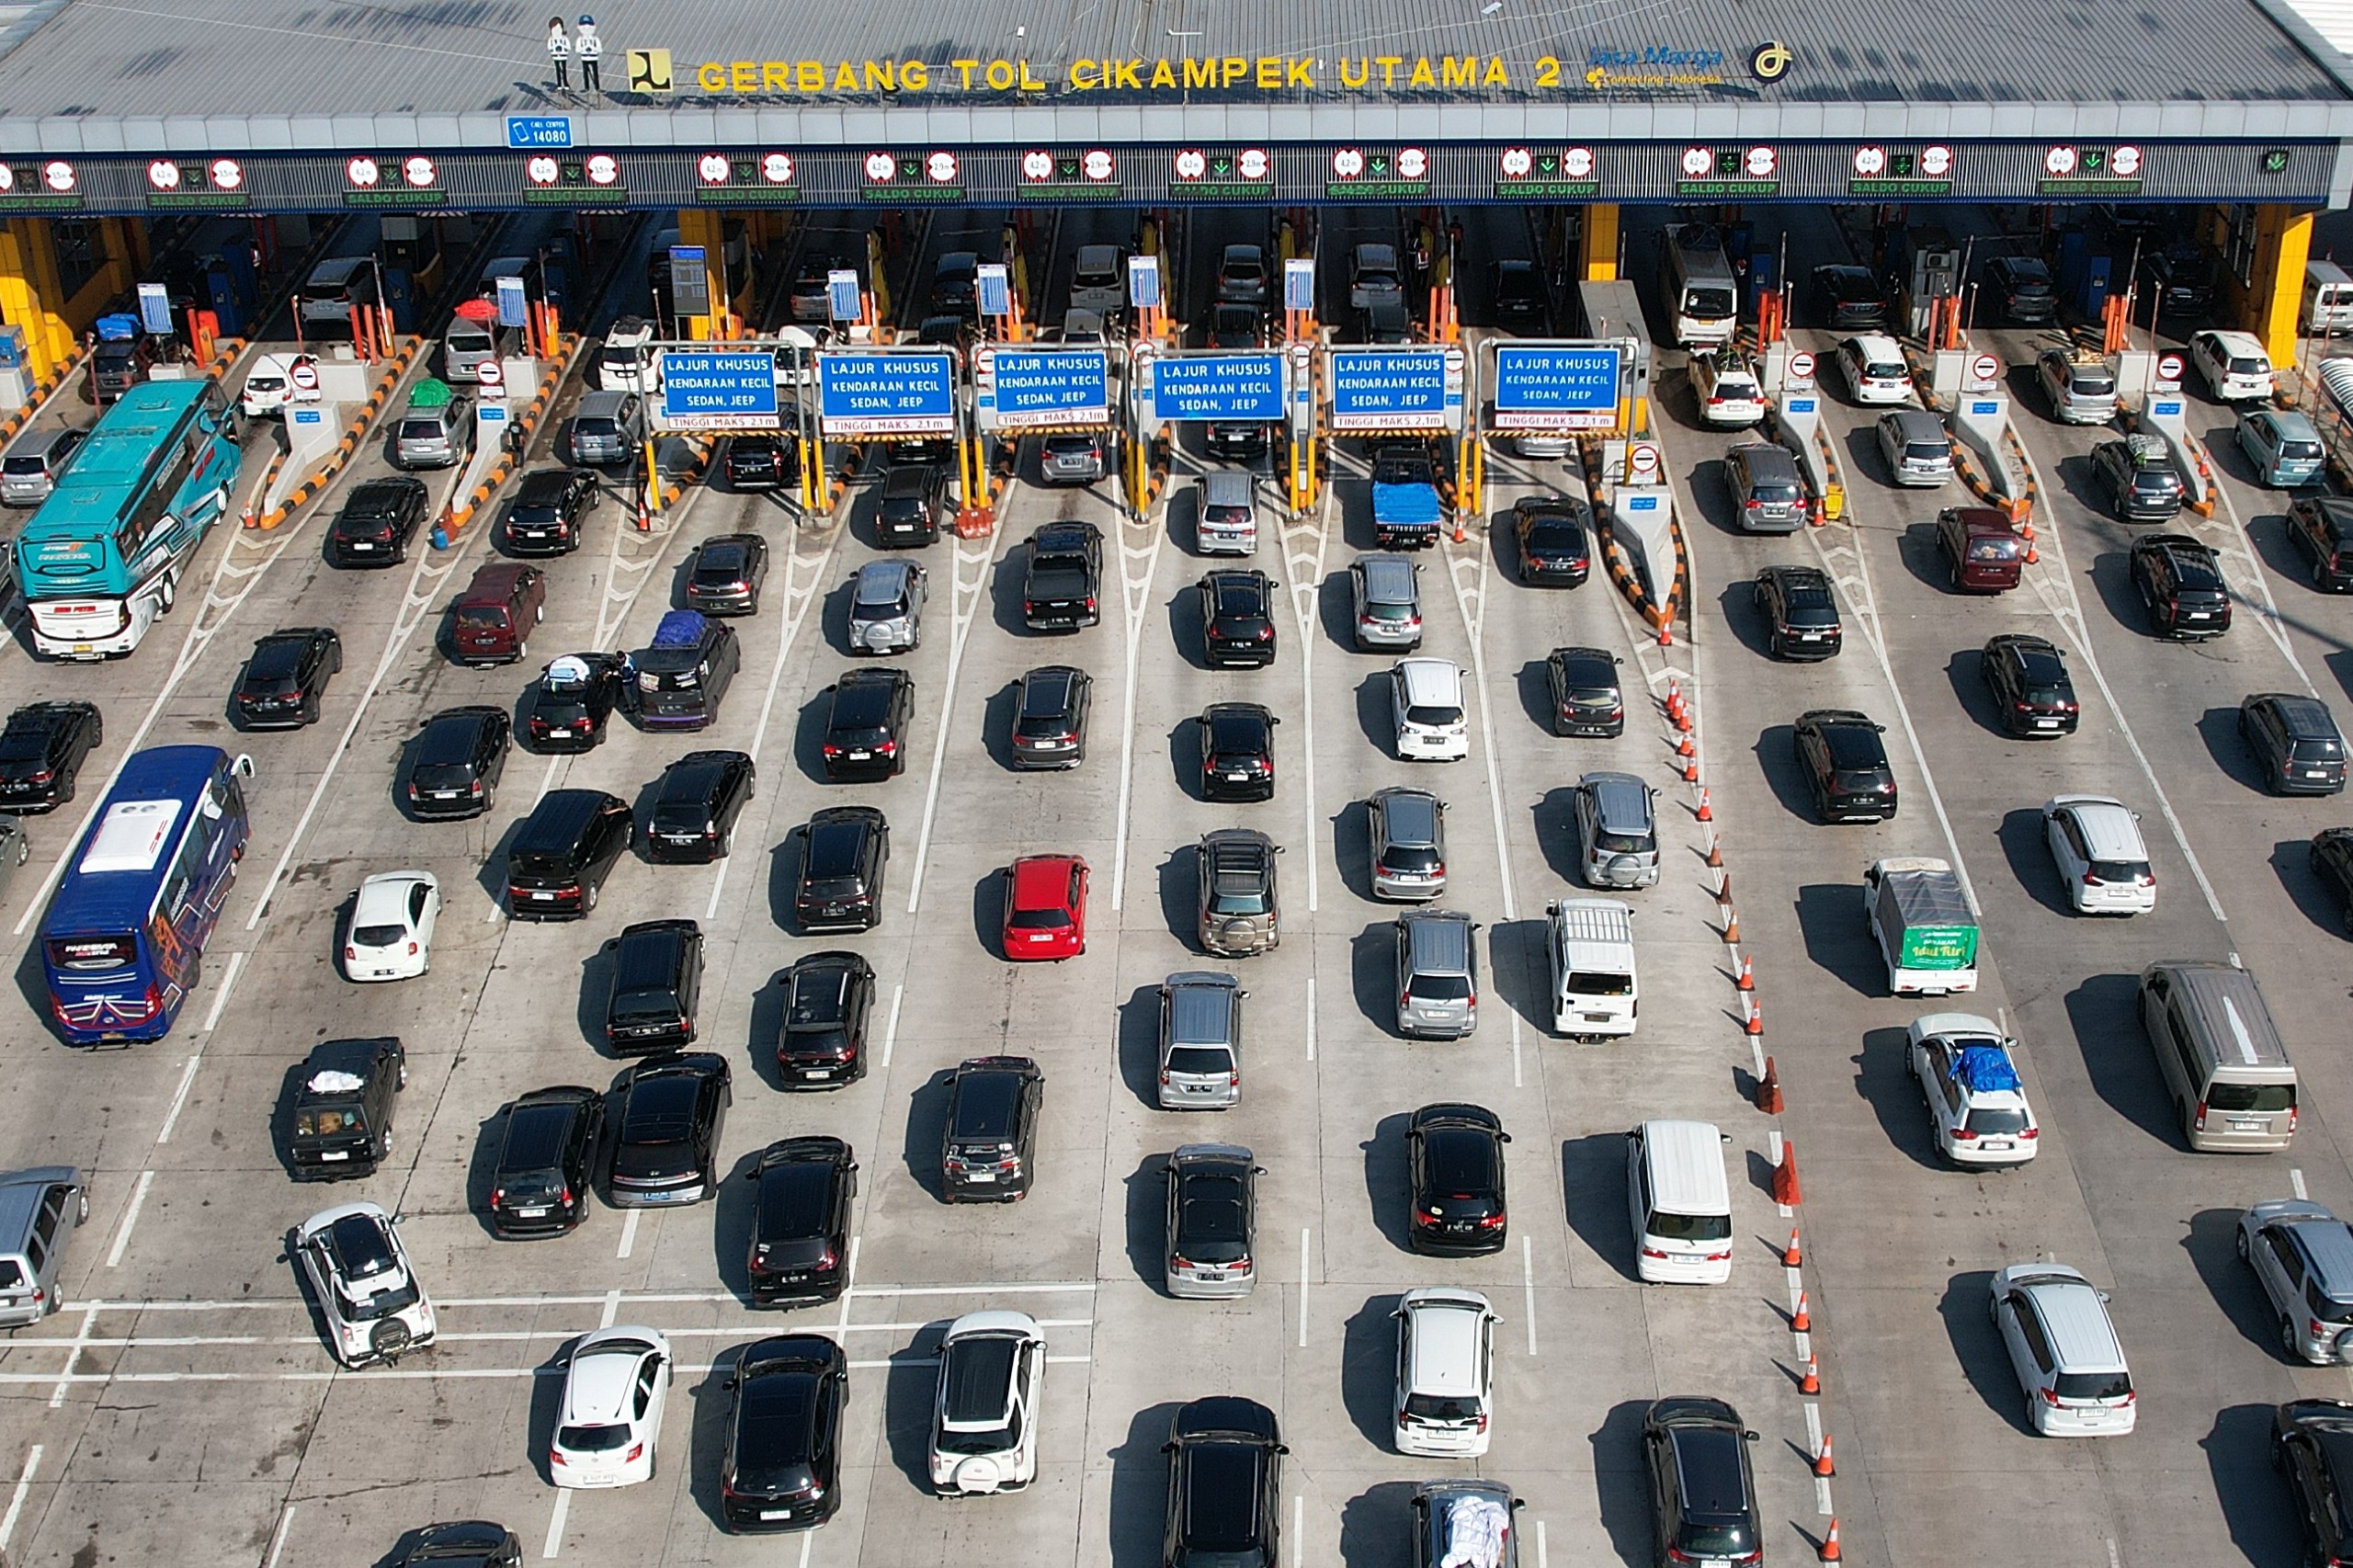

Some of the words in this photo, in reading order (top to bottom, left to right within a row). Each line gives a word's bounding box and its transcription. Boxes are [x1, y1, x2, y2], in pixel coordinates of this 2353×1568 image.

[1644, 45, 1722, 72] Marga
[698, 60, 928, 92] GERBANG
[951, 60, 1046, 90] TOL
[1070, 57, 1314, 89] CIKAMPEK
[1340, 56, 1509, 87] UTAMA
[1535, 56, 1560, 87] 2
[1603, 74, 1665, 85] Connecting
[1669, 74, 1721, 85] Indonesia
[533, 131, 567, 143] 14080
[1222, 186, 1268, 195] CUKUP
[1500, 185, 1544, 194] SALDO
[1548, 185, 1595, 194] CUKUP
[1680, 184, 1725, 193] SALDO
[1729, 184, 1776, 193] CUKUP
[1853, 183, 1897, 192] SALDO
[1902, 183, 1949, 192] CUKUP
[2043, 183, 2087, 192] SALDO
[2091, 183, 2138, 192] CUKUP
[348, 194, 392, 202] SALDO
[396, 193, 442, 202] CUKUP
[529, 191, 572, 200] SALDO
[576, 191, 622, 200] CUKUP
[700, 190, 745, 199] SALDO
[749, 190, 795, 199] CUKUP
[865, 189, 909, 199] SALDO
[914, 189, 961, 199] CUKUP
[152, 196, 195, 205] SALDO
[199, 196, 245, 205] CUKUP
[666, 359, 710, 371] LAJUR
[716, 359, 768, 371] KHUSUS
[831, 362, 874, 374] LAJUR
[884, 362, 939, 374] KHUSUS
[998, 358, 1040, 371] LAJUR
[1048, 358, 1101, 370] KHUSUS
[1338, 359, 1381, 371] LAJUR
[1387, 359, 1440, 371] KHUSUS
[1506, 358, 1550, 369] LAJUR
[1555, 358, 1609, 369] KHUSUS
[1163, 365, 1208, 378] LAJUR
[1217, 363, 1271, 377] KHUSUS
[668, 378, 735, 389] KENDARAAN
[741, 378, 770, 389] KECIL
[998, 376, 1066, 389] KENDARAAN
[1071, 375, 1101, 386] KECIL
[1338, 378, 1406, 390] KENDARAAN
[1411, 377, 1441, 388] KECIL
[1506, 375, 1574, 384] KENDARAAN
[1578, 375, 1609, 385] KECIL
[831, 381, 904, 392] KENDARAAN
[909, 381, 939, 392] KECIL
[1164, 383, 1234, 395] KENDARAAN
[1240, 382, 1271, 393] KECIL
[687, 395, 727, 407] SEDAN,
[731, 395, 756, 405] JEEP
[1016, 392, 1056, 405] SEDAN,
[1061, 392, 1086, 403] JEEP
[1351, 395, 1393, 407] SEDAN,
[1400, 394, 1428, 406] JEEP
[1522, 391, 1562, 401] SEDAN,
[1566, 391, 1592, 400] JEEP
[850, 397, 891, 409] SEDAN,
[897, 397, 923, 407] JEEP
[1178, 400, 1222, 412] SEDAN,
[1231, 399, 1258, 410] JEEP
[673, 418, 710, 427] TINGGI
[1004, 415, 1039, 425] TINGGI
[1338, 417, 1373, 426] TINGGI
[1503, 416, 1540, 425] TINGGI
[834, 421, 871, 431] TINGGI
[1912, 946, 1938, 957] Idul
